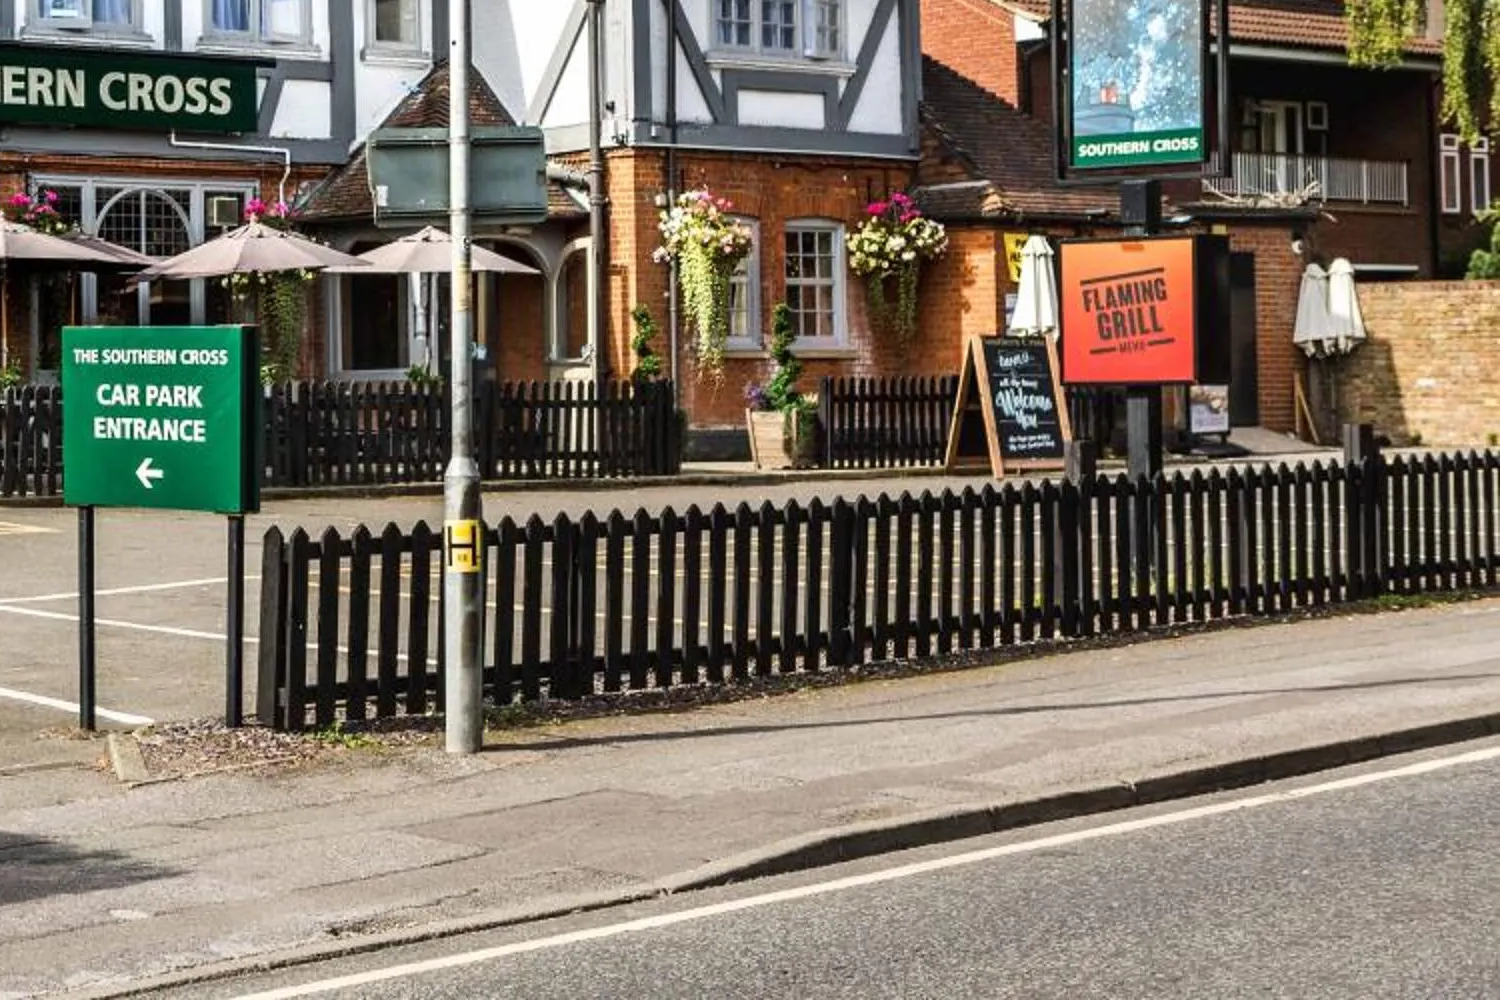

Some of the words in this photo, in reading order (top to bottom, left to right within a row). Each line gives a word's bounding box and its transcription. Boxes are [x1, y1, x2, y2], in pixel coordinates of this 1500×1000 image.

[99, 72, 232, 116] CROSS
[1078, 140, 1150, 157] SOUTHERN
[1152, 137, 1199, 153] CROSS
[1082, 277, 1168, 312] FLAMING
[1097, 305, 1164, 340] GRILL
[73, 348, 99, 364] THE
[102, 348, 177, 365] SOUTHERN
[180, 349, 229, 366] CROSS
[96, 383, 141, 407] CAR
[145, 385, 203, 408] PARK
[93, 417, 207, 442] ENTRANCE
